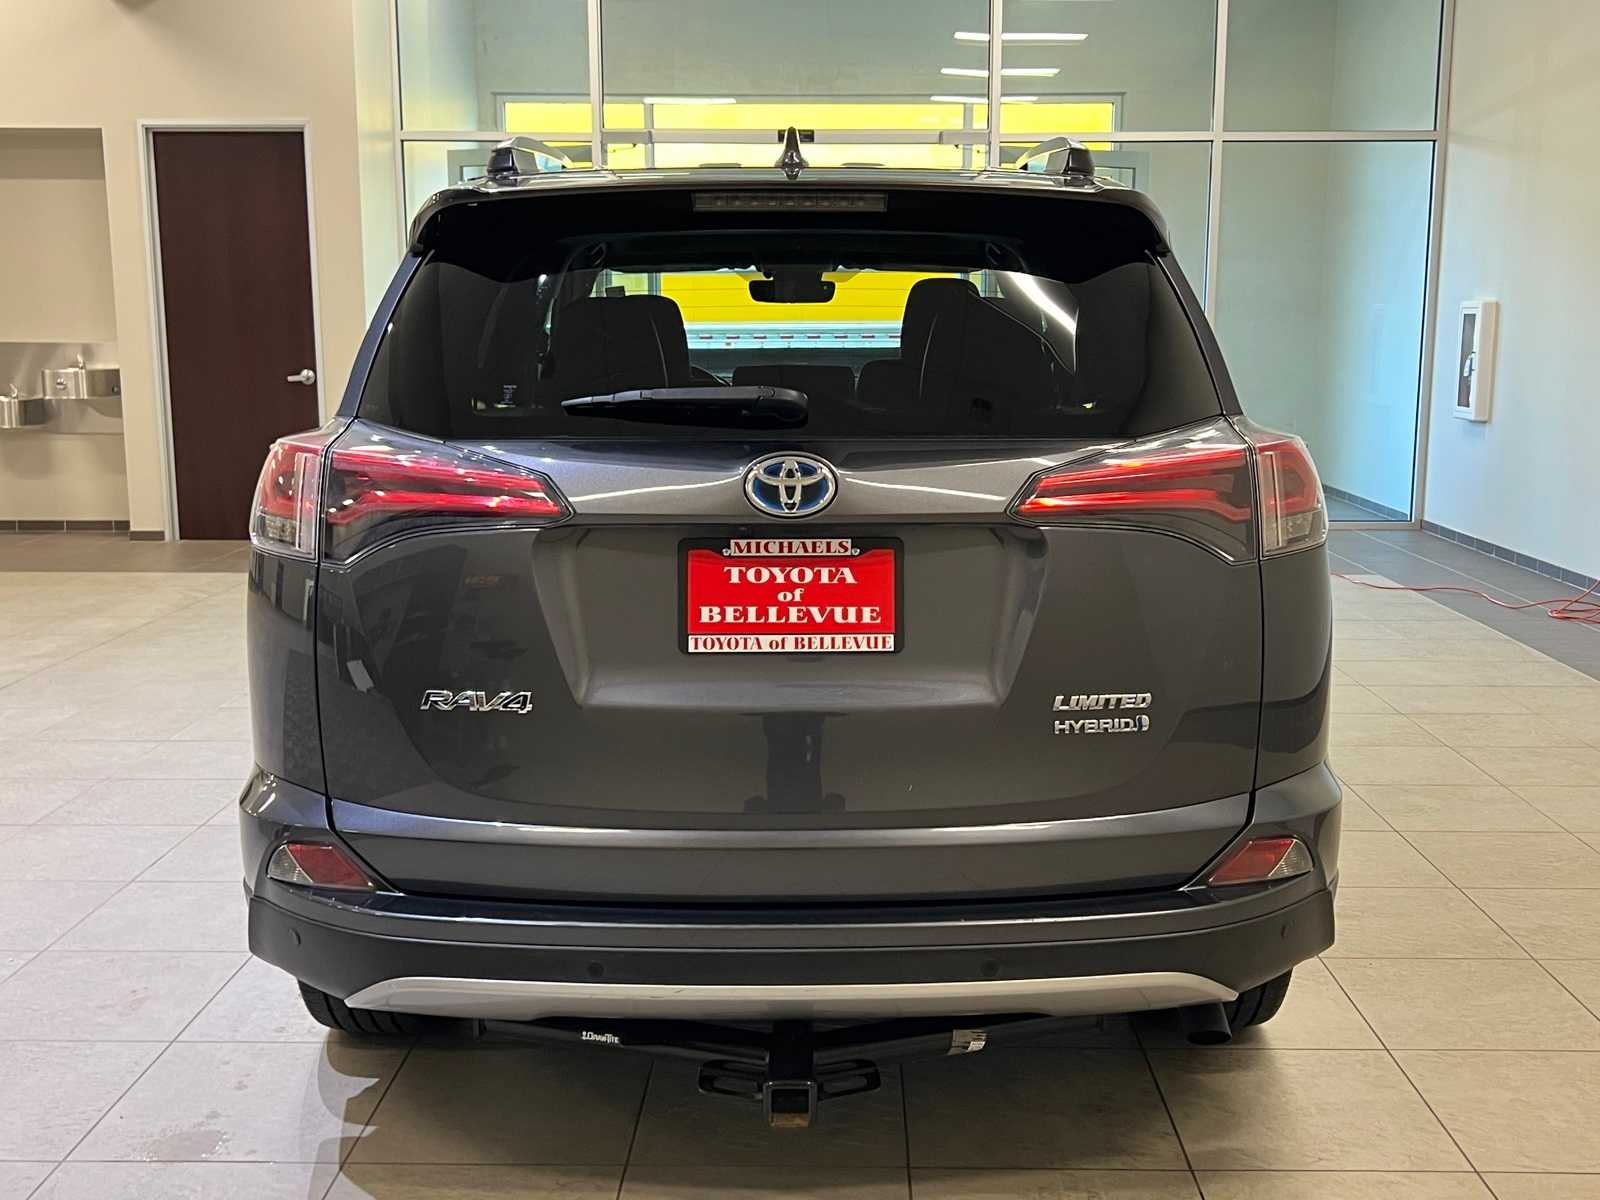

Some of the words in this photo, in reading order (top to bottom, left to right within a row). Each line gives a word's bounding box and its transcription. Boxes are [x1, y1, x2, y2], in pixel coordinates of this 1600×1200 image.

[732, 540, 850, 554] MICHAELS
[723, 566, 858, 584] TOYOTA
[777, 587, 805, 602] of
[698, 606, 881, 624] BELLEVUE
[690, 636, 763, 650] TOYOTA
[769, 635, 788, 651] of
[793, 635, 893, 650] BELLEVUE
[419, 689, 533, 714] RAV4
[1052, 692, 1152, 711] LIMITED
[1054, 718, 1137, 734] HYBRID
